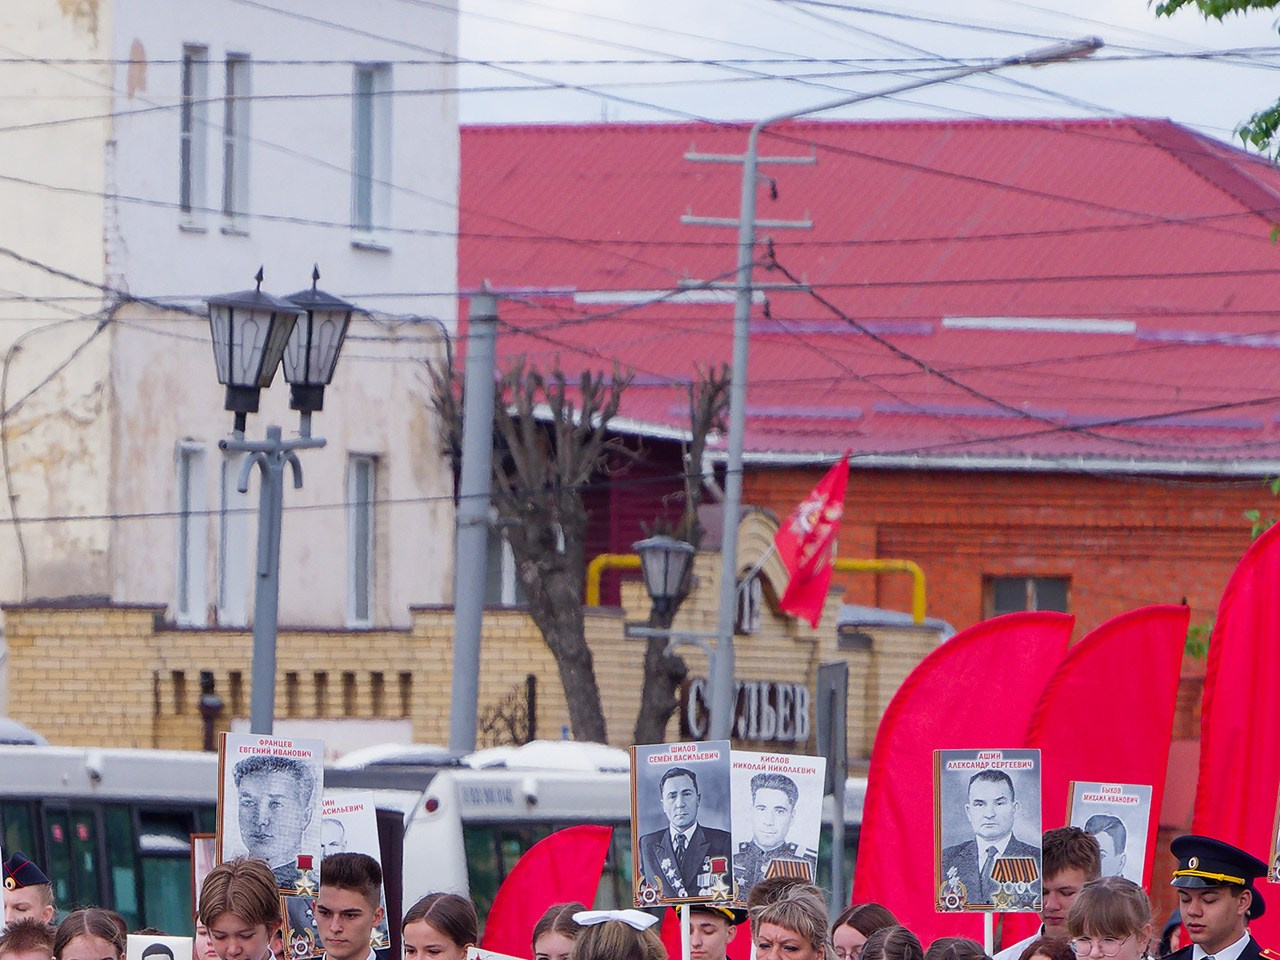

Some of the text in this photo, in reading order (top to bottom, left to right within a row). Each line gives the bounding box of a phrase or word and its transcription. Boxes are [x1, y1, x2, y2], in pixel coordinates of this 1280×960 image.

[258, 739, 293, 748] ФРАНЦЕВ
[239, 746, 312, 758] ЕВГЕНИЙ ИВАНОВИЧ
[670, 745, 696, 753] ШИЛОВ
[673, 752, 719, 762] ВАСИЛЬЕВИЧ
[760, 755, 790, 764] КИСЛОВ
[732, 762, 816, 774] НИКОЛАЙ НИКОЛАЕВИЧ
[948, 761, 1032, 769] АЛЕКСАНДР СЕРГЕЕВИЧ
[1101, 786, 1122, 794] БЫКОВ
[1083, 794, 1138, 803] МИХАИЛ ИВАНОВИЧ
[322, 804, 364, 815] АСИЛЬЕВИЧ
